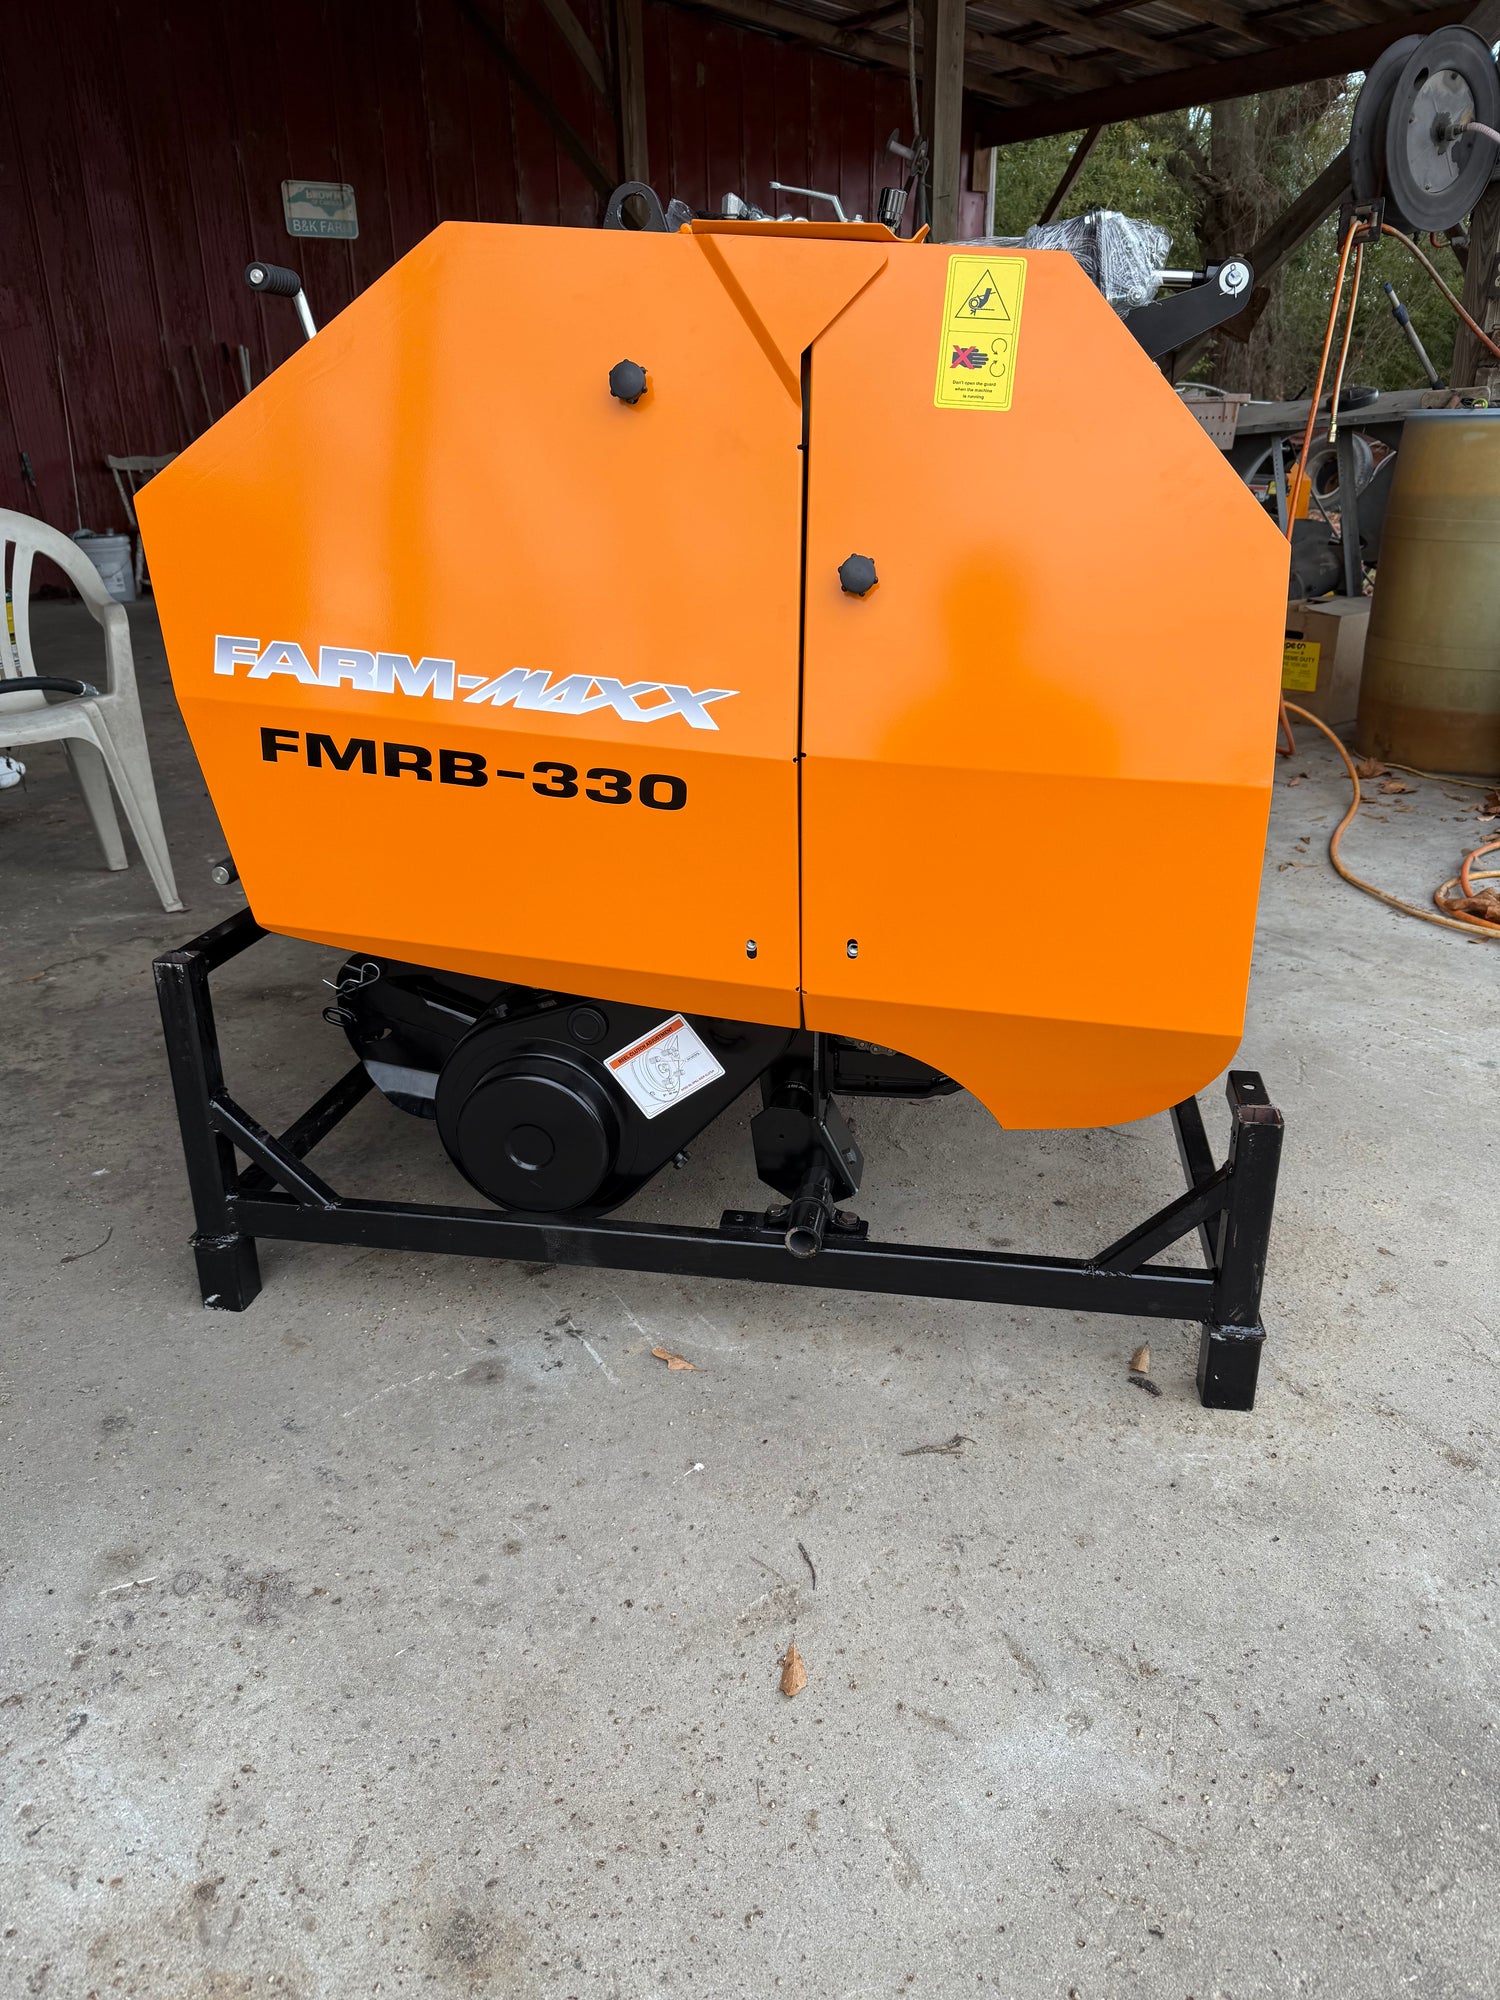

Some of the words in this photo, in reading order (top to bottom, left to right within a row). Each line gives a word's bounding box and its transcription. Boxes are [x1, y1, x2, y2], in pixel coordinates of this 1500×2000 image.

[292, 219, 318, 232] B&K
[260, 727, 688, 811] FMRB-330
[617, 1054, 631, 1064] REEL
[629, 1043, 647, 1058] CLUTCH
[646, 1027, 674, 1048] ADJUSTMENT
